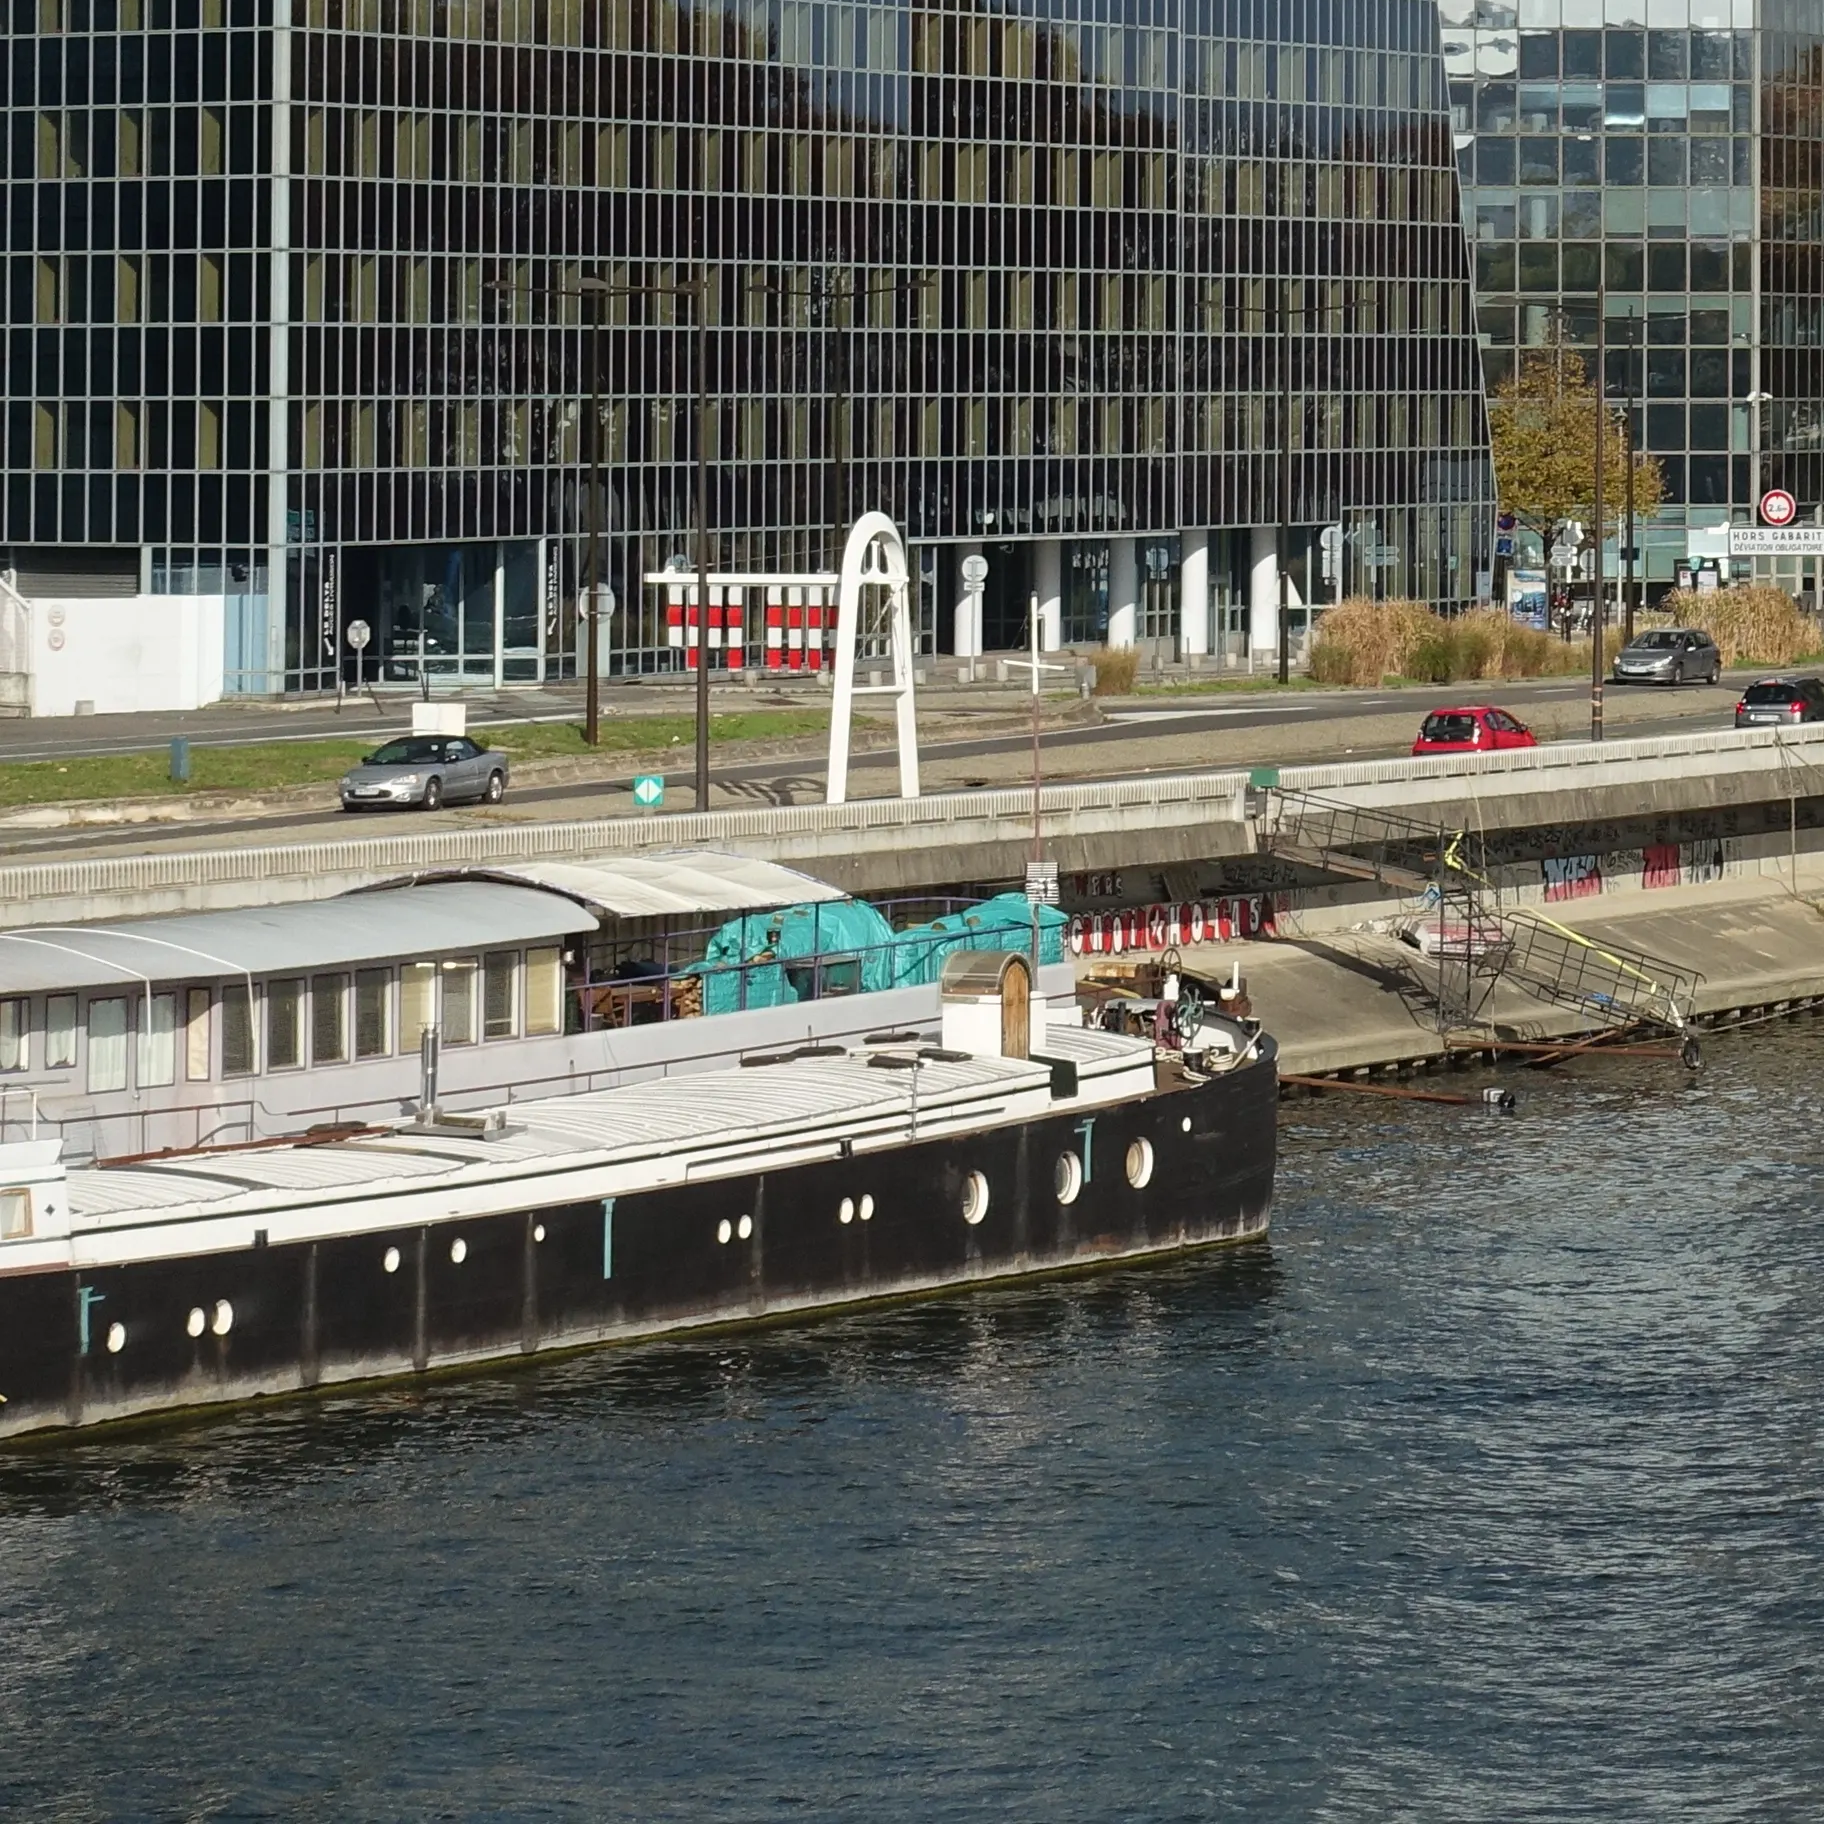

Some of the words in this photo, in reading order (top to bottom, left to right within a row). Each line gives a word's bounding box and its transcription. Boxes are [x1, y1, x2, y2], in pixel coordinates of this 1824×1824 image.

[1733, 531, 1765, 541] HORS
[1772, 531, 1822, 541] GABARIT
[1734, 542, 1773, 552] DÉVIATION
[1775, 543, 1823, 552] OBLIGATOIRE
